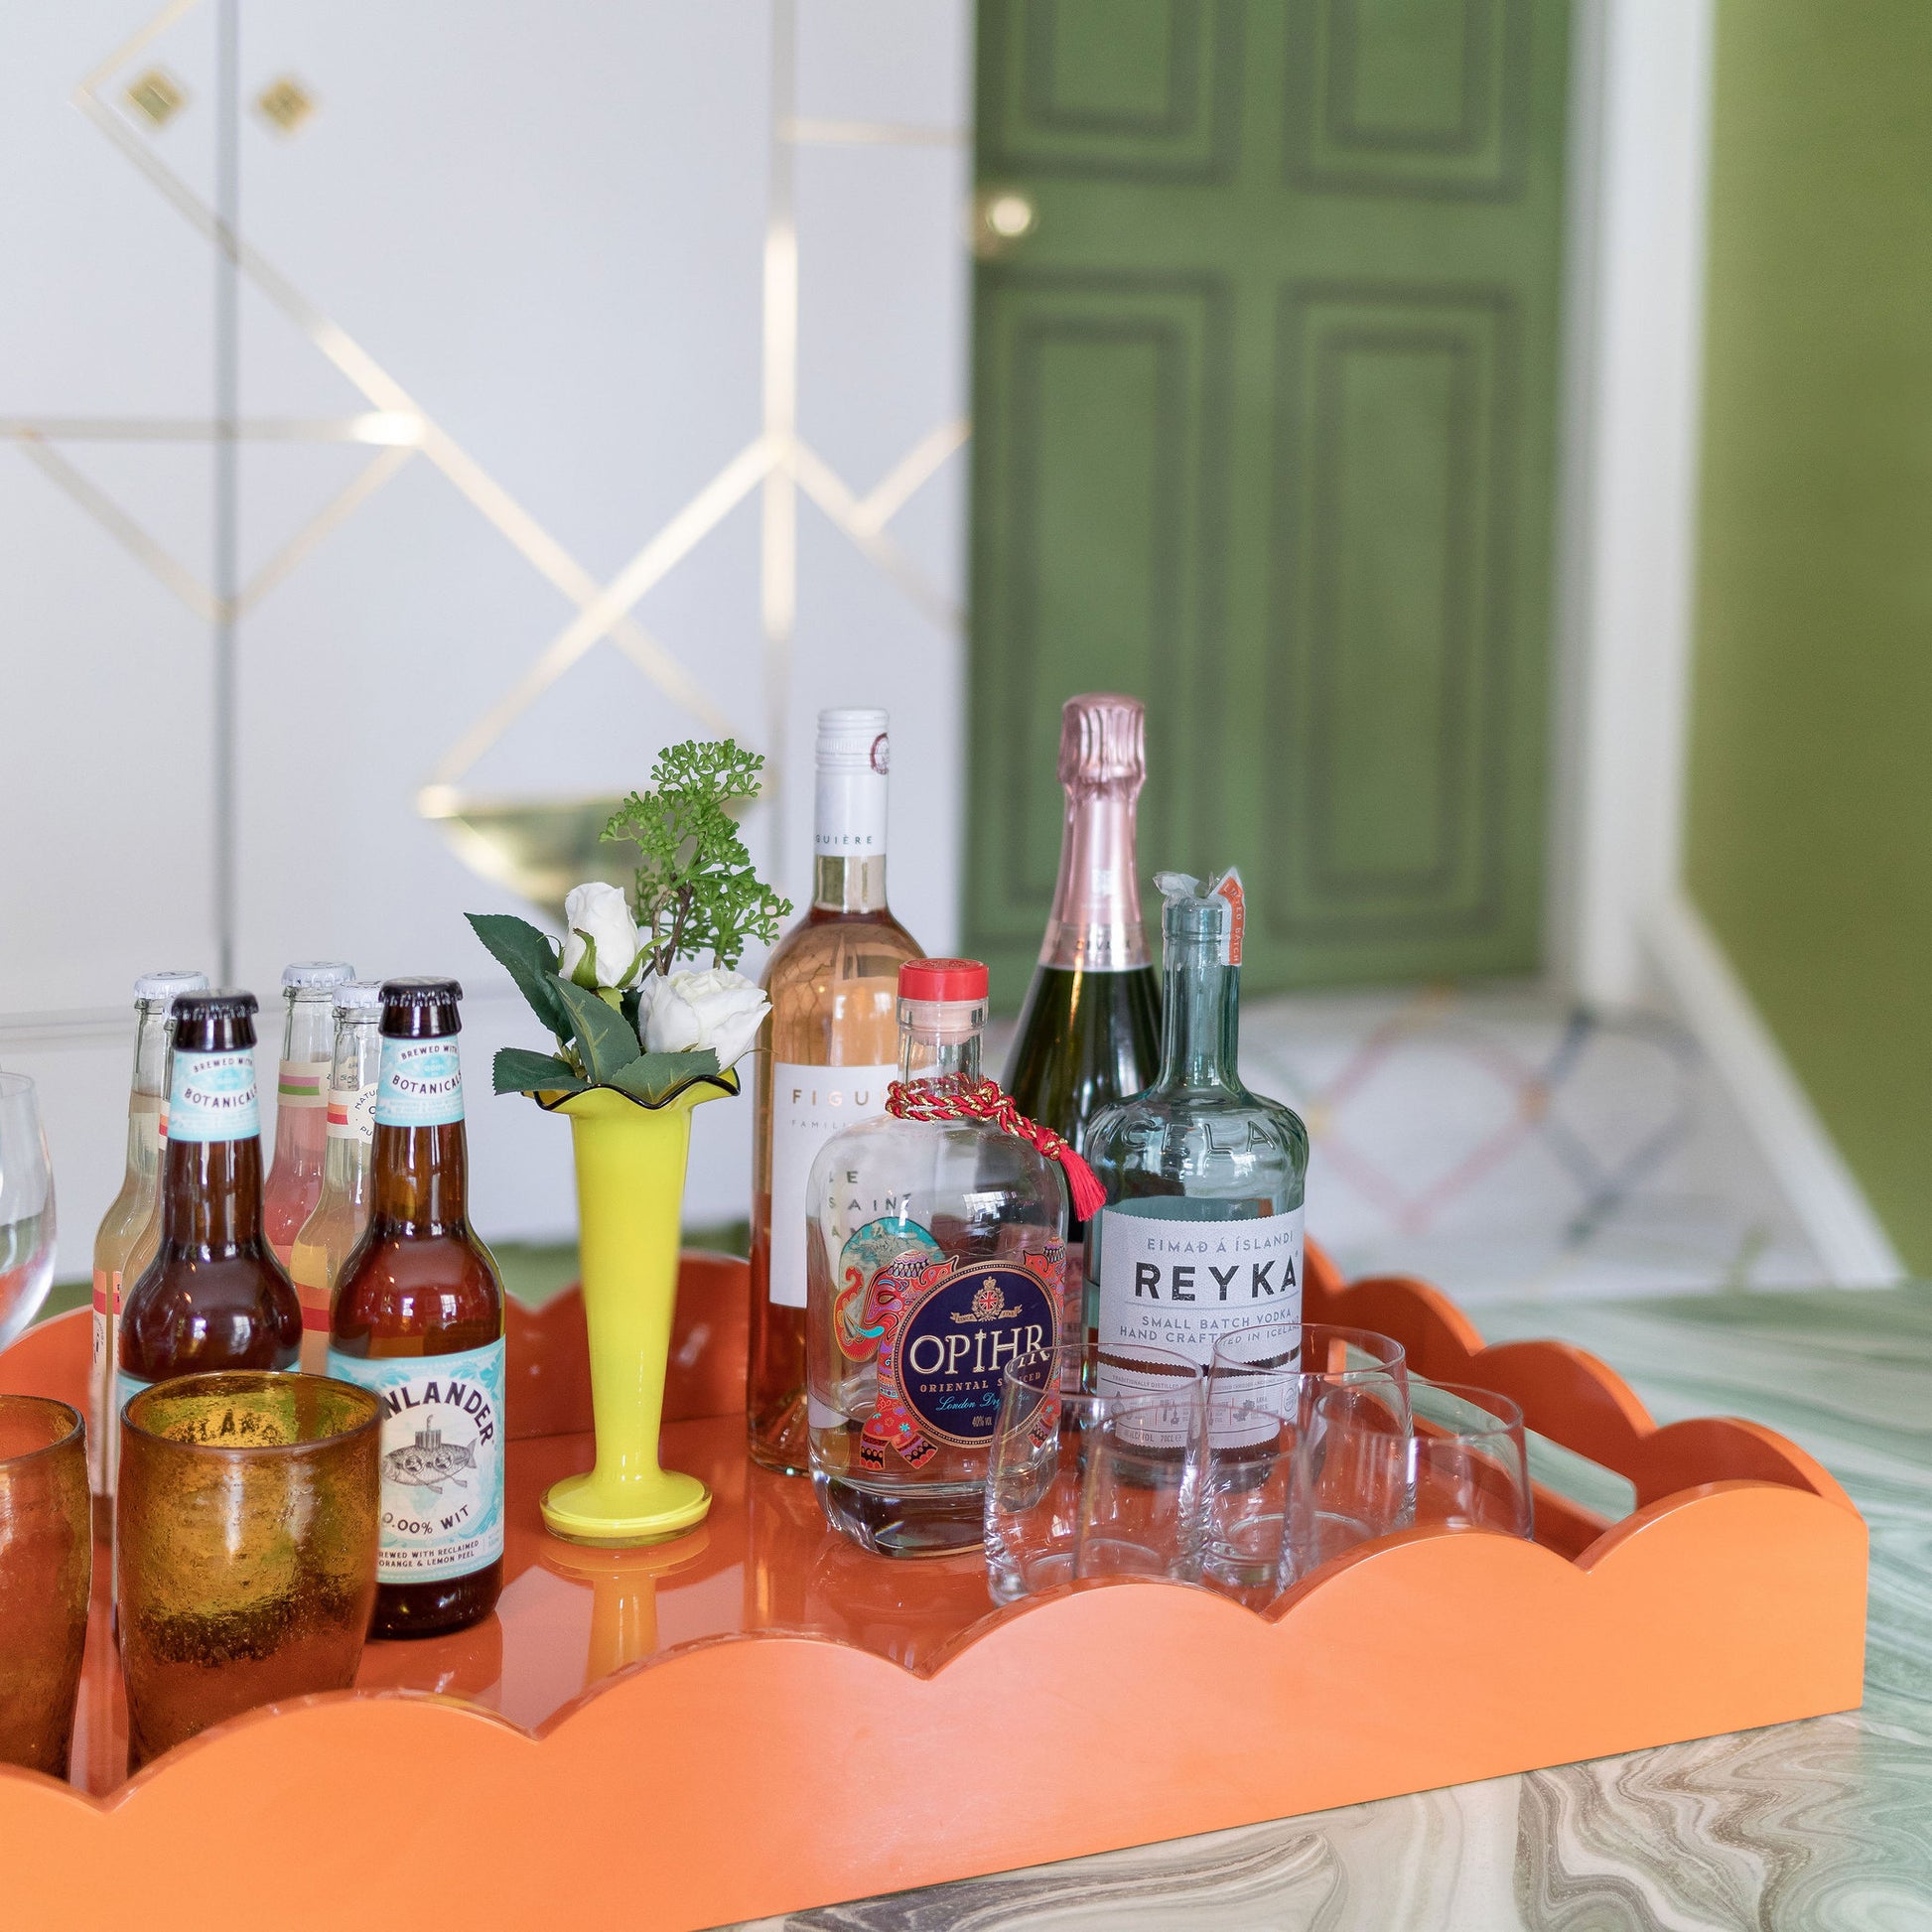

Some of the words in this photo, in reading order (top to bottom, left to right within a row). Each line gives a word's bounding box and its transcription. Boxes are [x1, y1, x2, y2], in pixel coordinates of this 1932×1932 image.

[401, 1044, 440, 1060] BREWED
[193, 1056, 235, 1073] BREWED
[392, 1069, 462, 1094] BOTANICALS
[1216, 1238, 1227, 1254] Á
[1134, 1255, 1297, 1302] REYKA
[1142, 1315, 1191, 1329] SMALL
[1200, 1316, 1250, 1329] BATCH
[1256, 1309, 1292, 1324] VODKA
[1120, 1325, 1158, 1341] HAND
[1247, 1331, 1260, 1341] IN
[909, 1324, 1050, 1375] OPIHR
[920, 1379, 989, 1393] ORIENTAL
[935, 1395, 976, 1412] London
[440, 1504, 470, 1530] WIT
[438, 1540, 480, 1556] RECLAIMED
[427, 1556, 455, 1566] LEMON
[458, 1550, 475, 1562] PEEL
